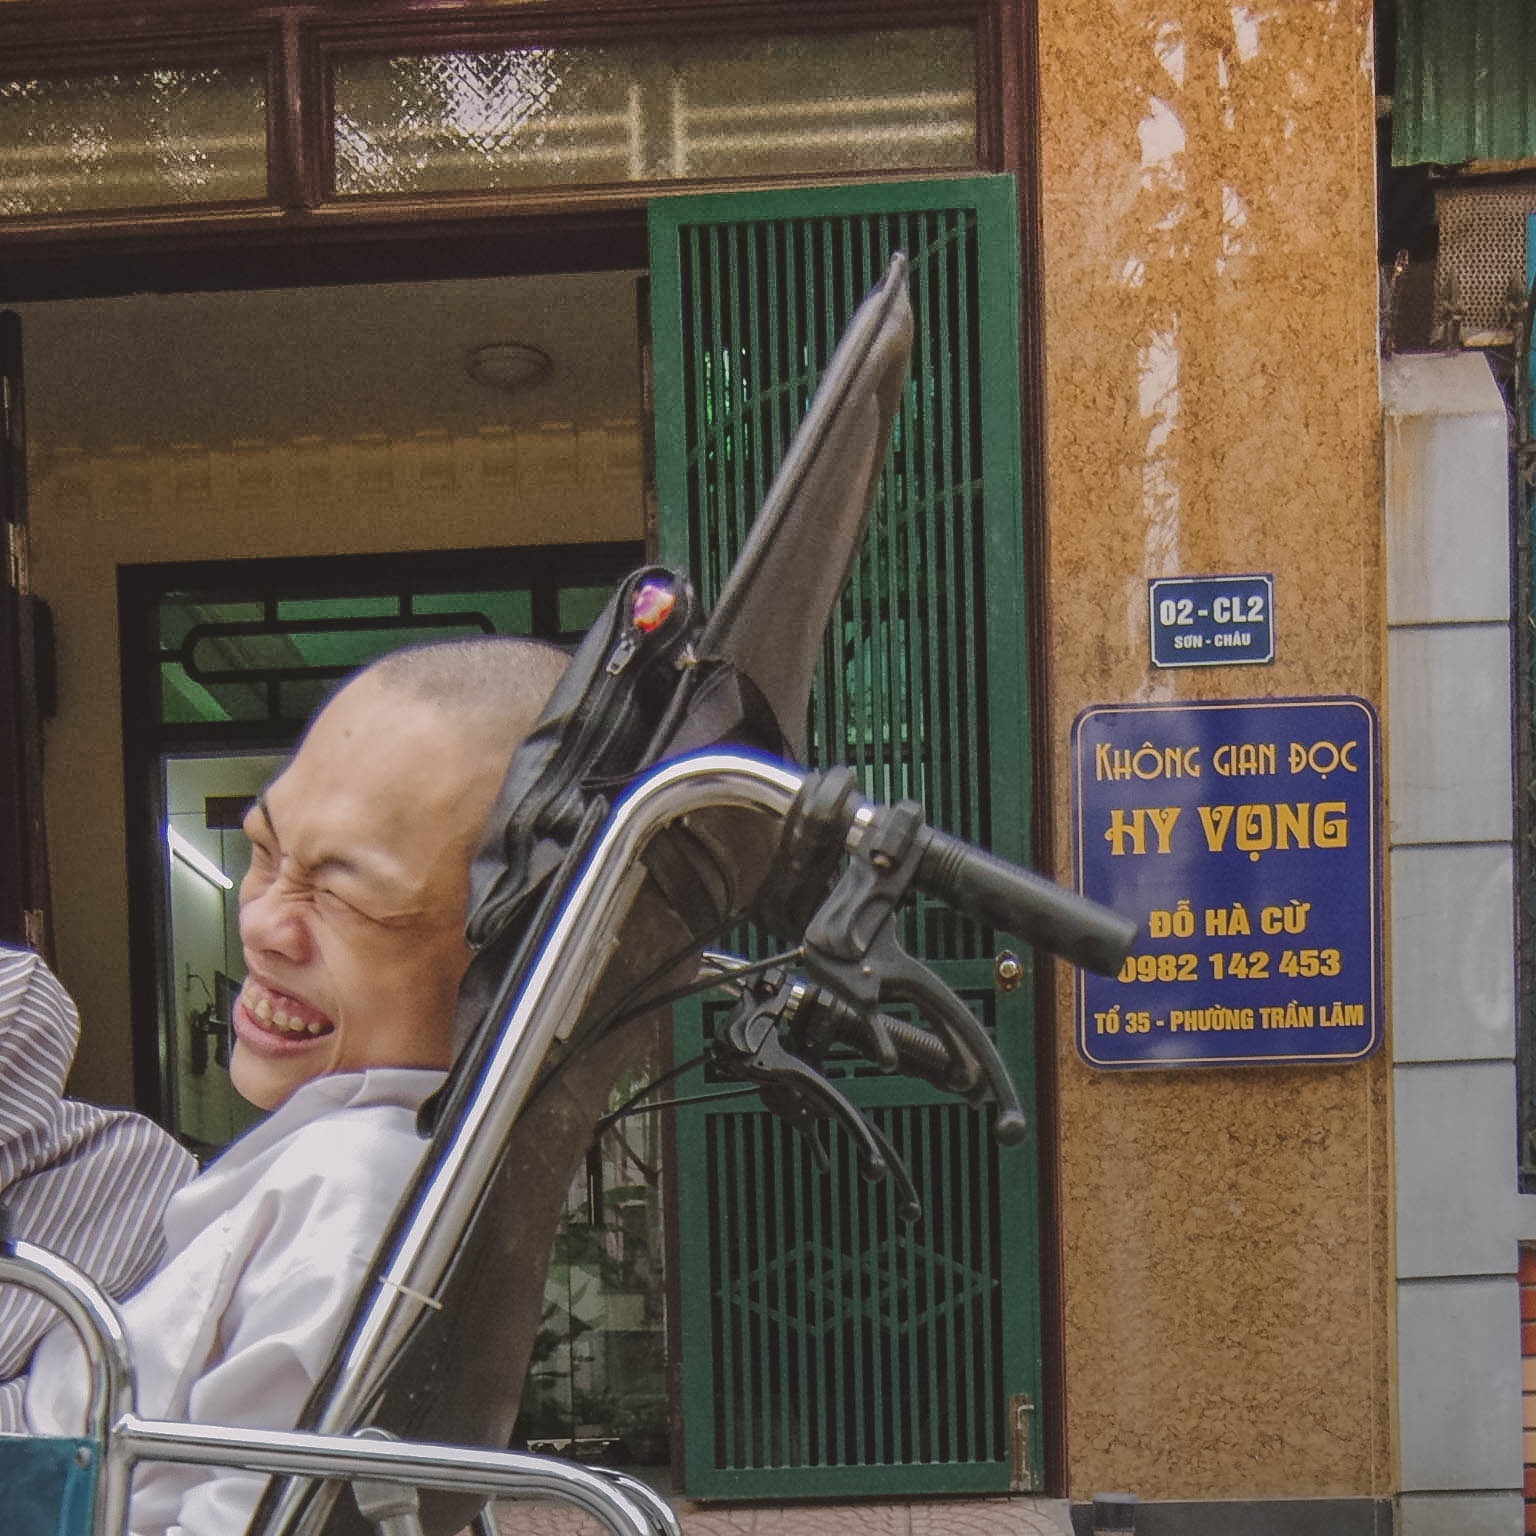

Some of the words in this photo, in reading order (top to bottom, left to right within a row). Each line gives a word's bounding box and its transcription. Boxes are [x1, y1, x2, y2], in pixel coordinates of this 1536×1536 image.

[1095, 740, 1201, 781] KHÔNG
[1213, 743, 1276, 777] GIAN
[1288, 740, 1358, 780] ĐỌC
[1104, 807, 1182, 855] HY
[1197, 802, 1349, 862] VỌNG
[1148, 900, 1195, 938] ĐỖ
[1205, 902, 1251, 936] HÀ
[1260, 900, 1311, 935] CỪ
[1117, 954, 1199, 984] 0982
[1209, 951, 1270, 980] 142
[1279, 949, 1342, 977] 453
[1094, 1004, 1121, 1034] TỔ
[1125, 1011, 1151, 1034] 35
[1170, 1003, 1254, 1032] PHƯỜNG
[1259, 999, 1314, 1029] TRẦN
